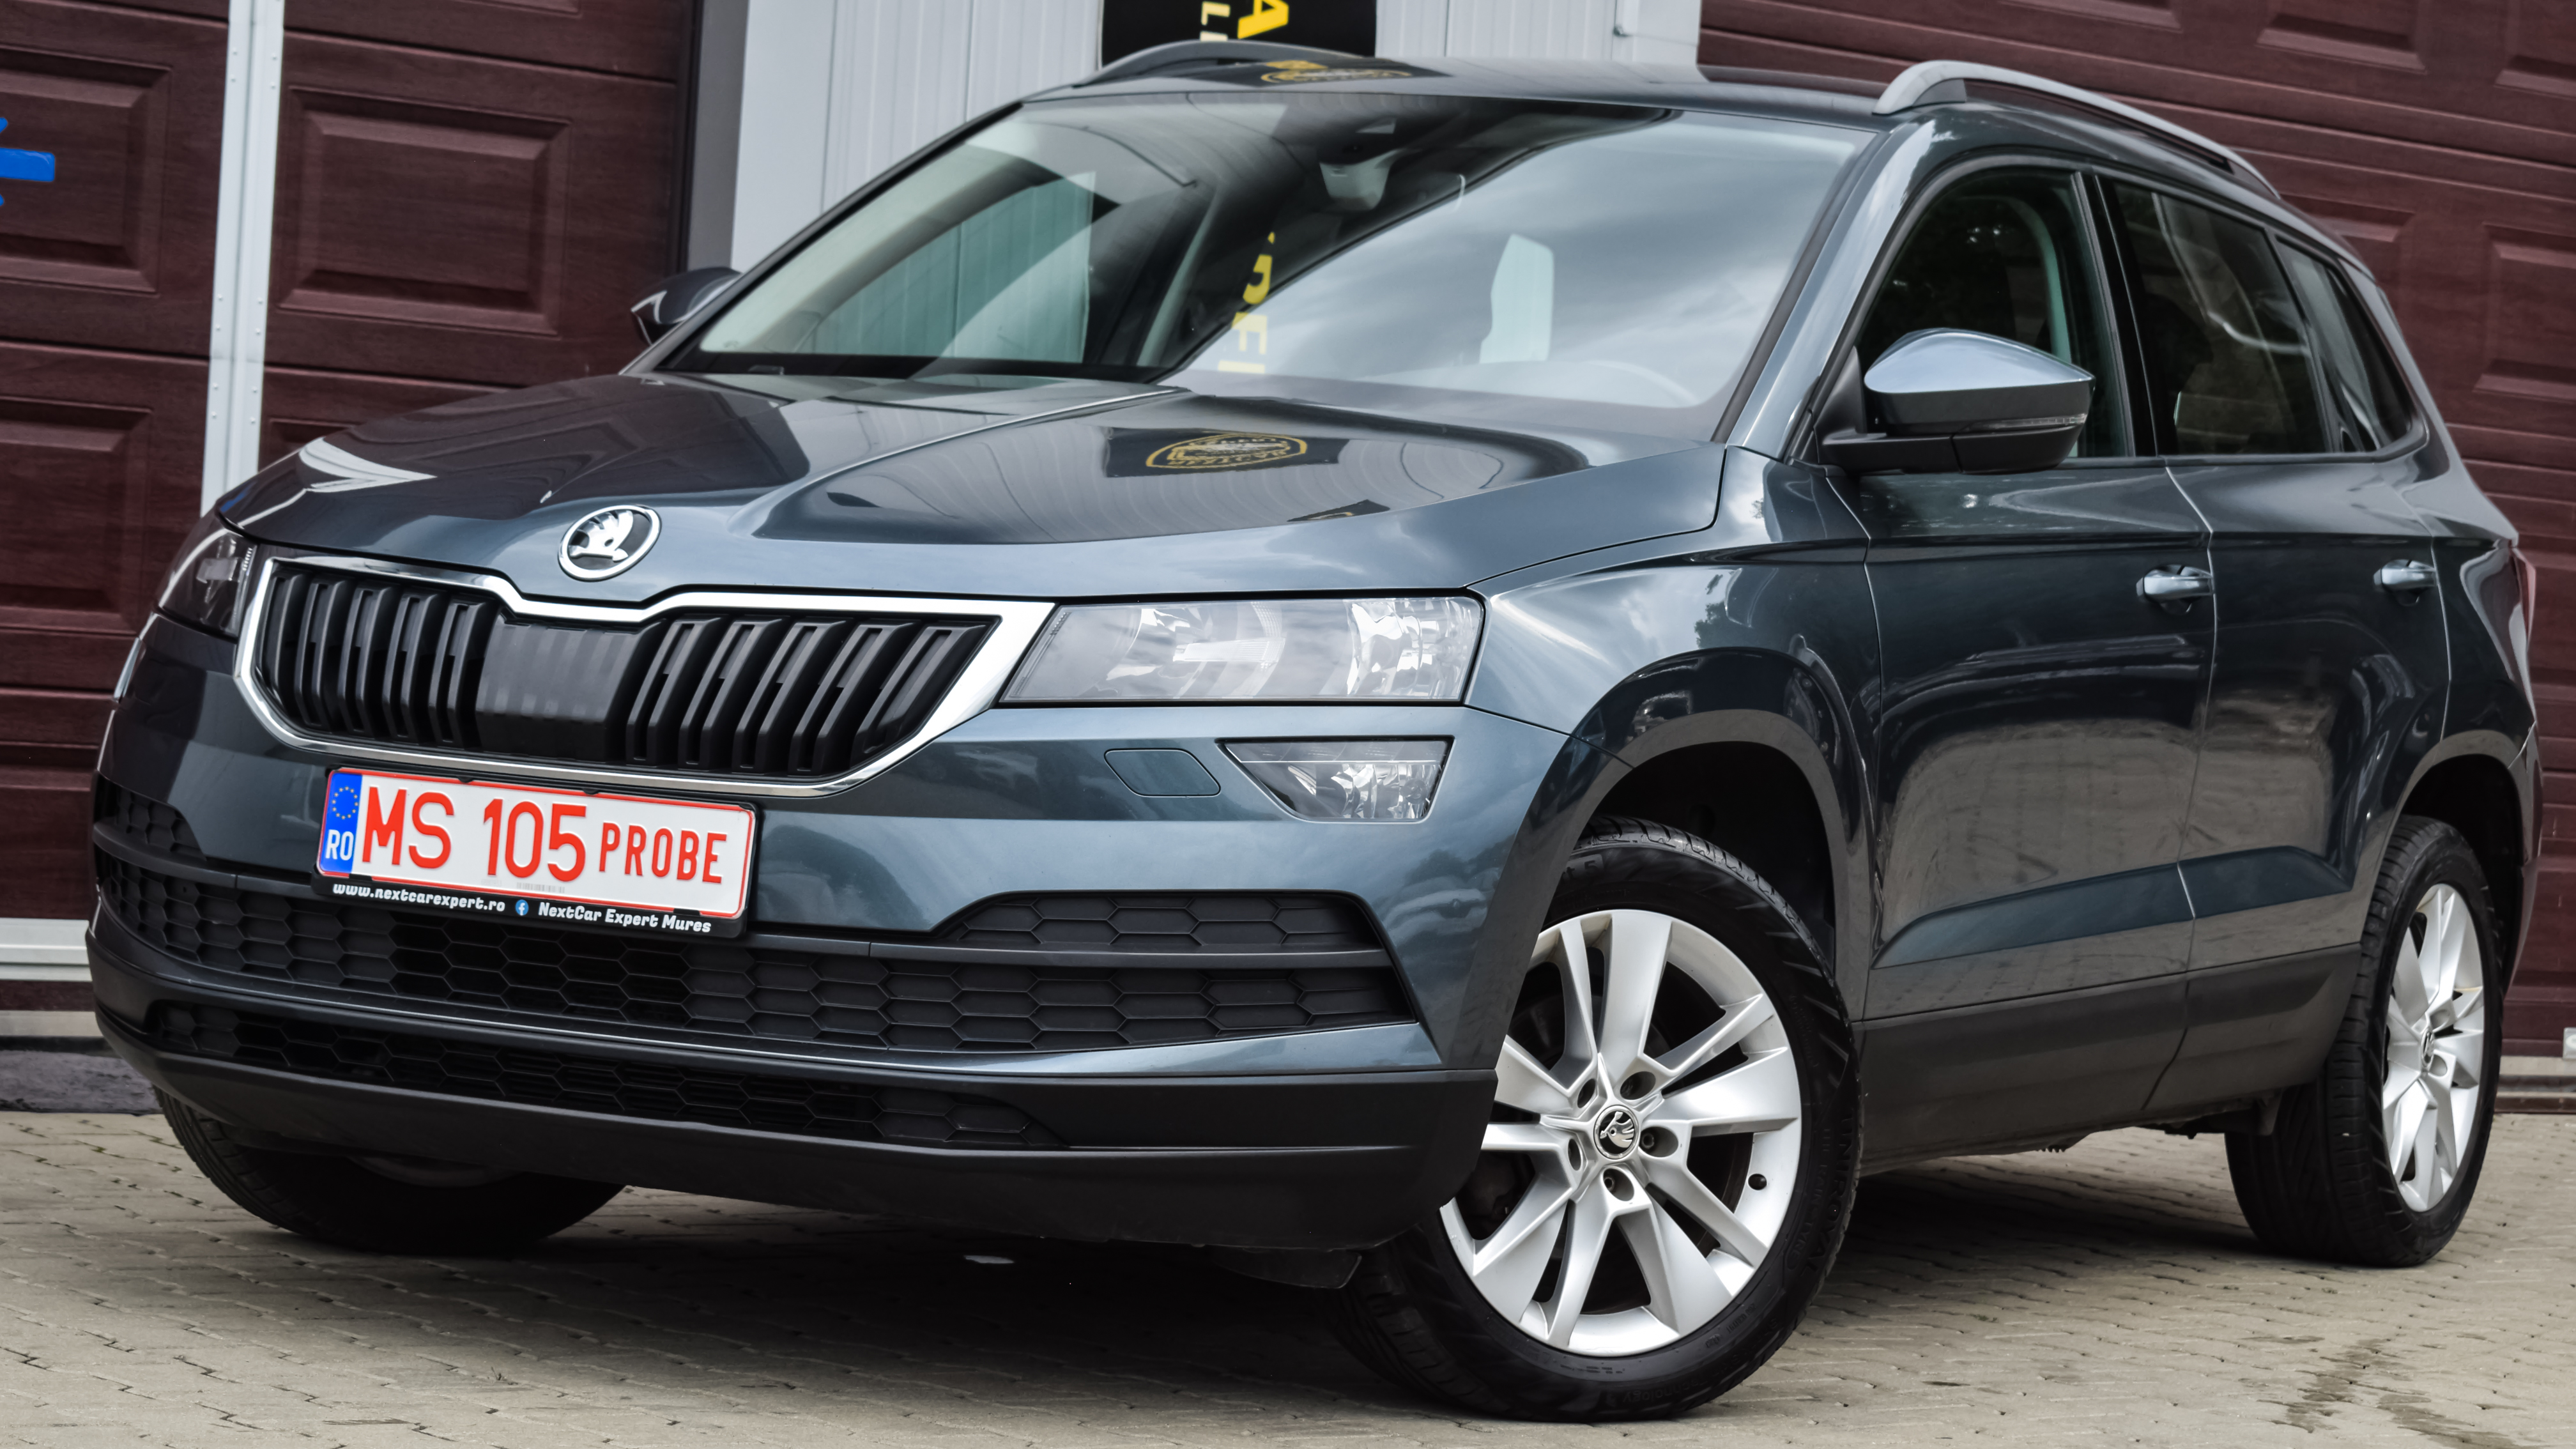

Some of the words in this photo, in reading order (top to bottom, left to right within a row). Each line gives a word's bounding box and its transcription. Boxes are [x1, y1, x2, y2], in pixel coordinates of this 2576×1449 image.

[325, 829, 354, 861] RO
[362, 786, 454, 869] MS
[484, 799, 586, 882] 105
[599, 822, 727, 884] PROBE
[332, 883, 505, 912] www.nextcarexpert.ro
[538, 901, 602, 921] NextCar
[605, 908, 659, 927] Expert
[662, 914, 712, 933] Mures
[1799, 1115, 1852, 1278] UNIROYAL
[1790, 1219, 1814, 1261] TYRE
